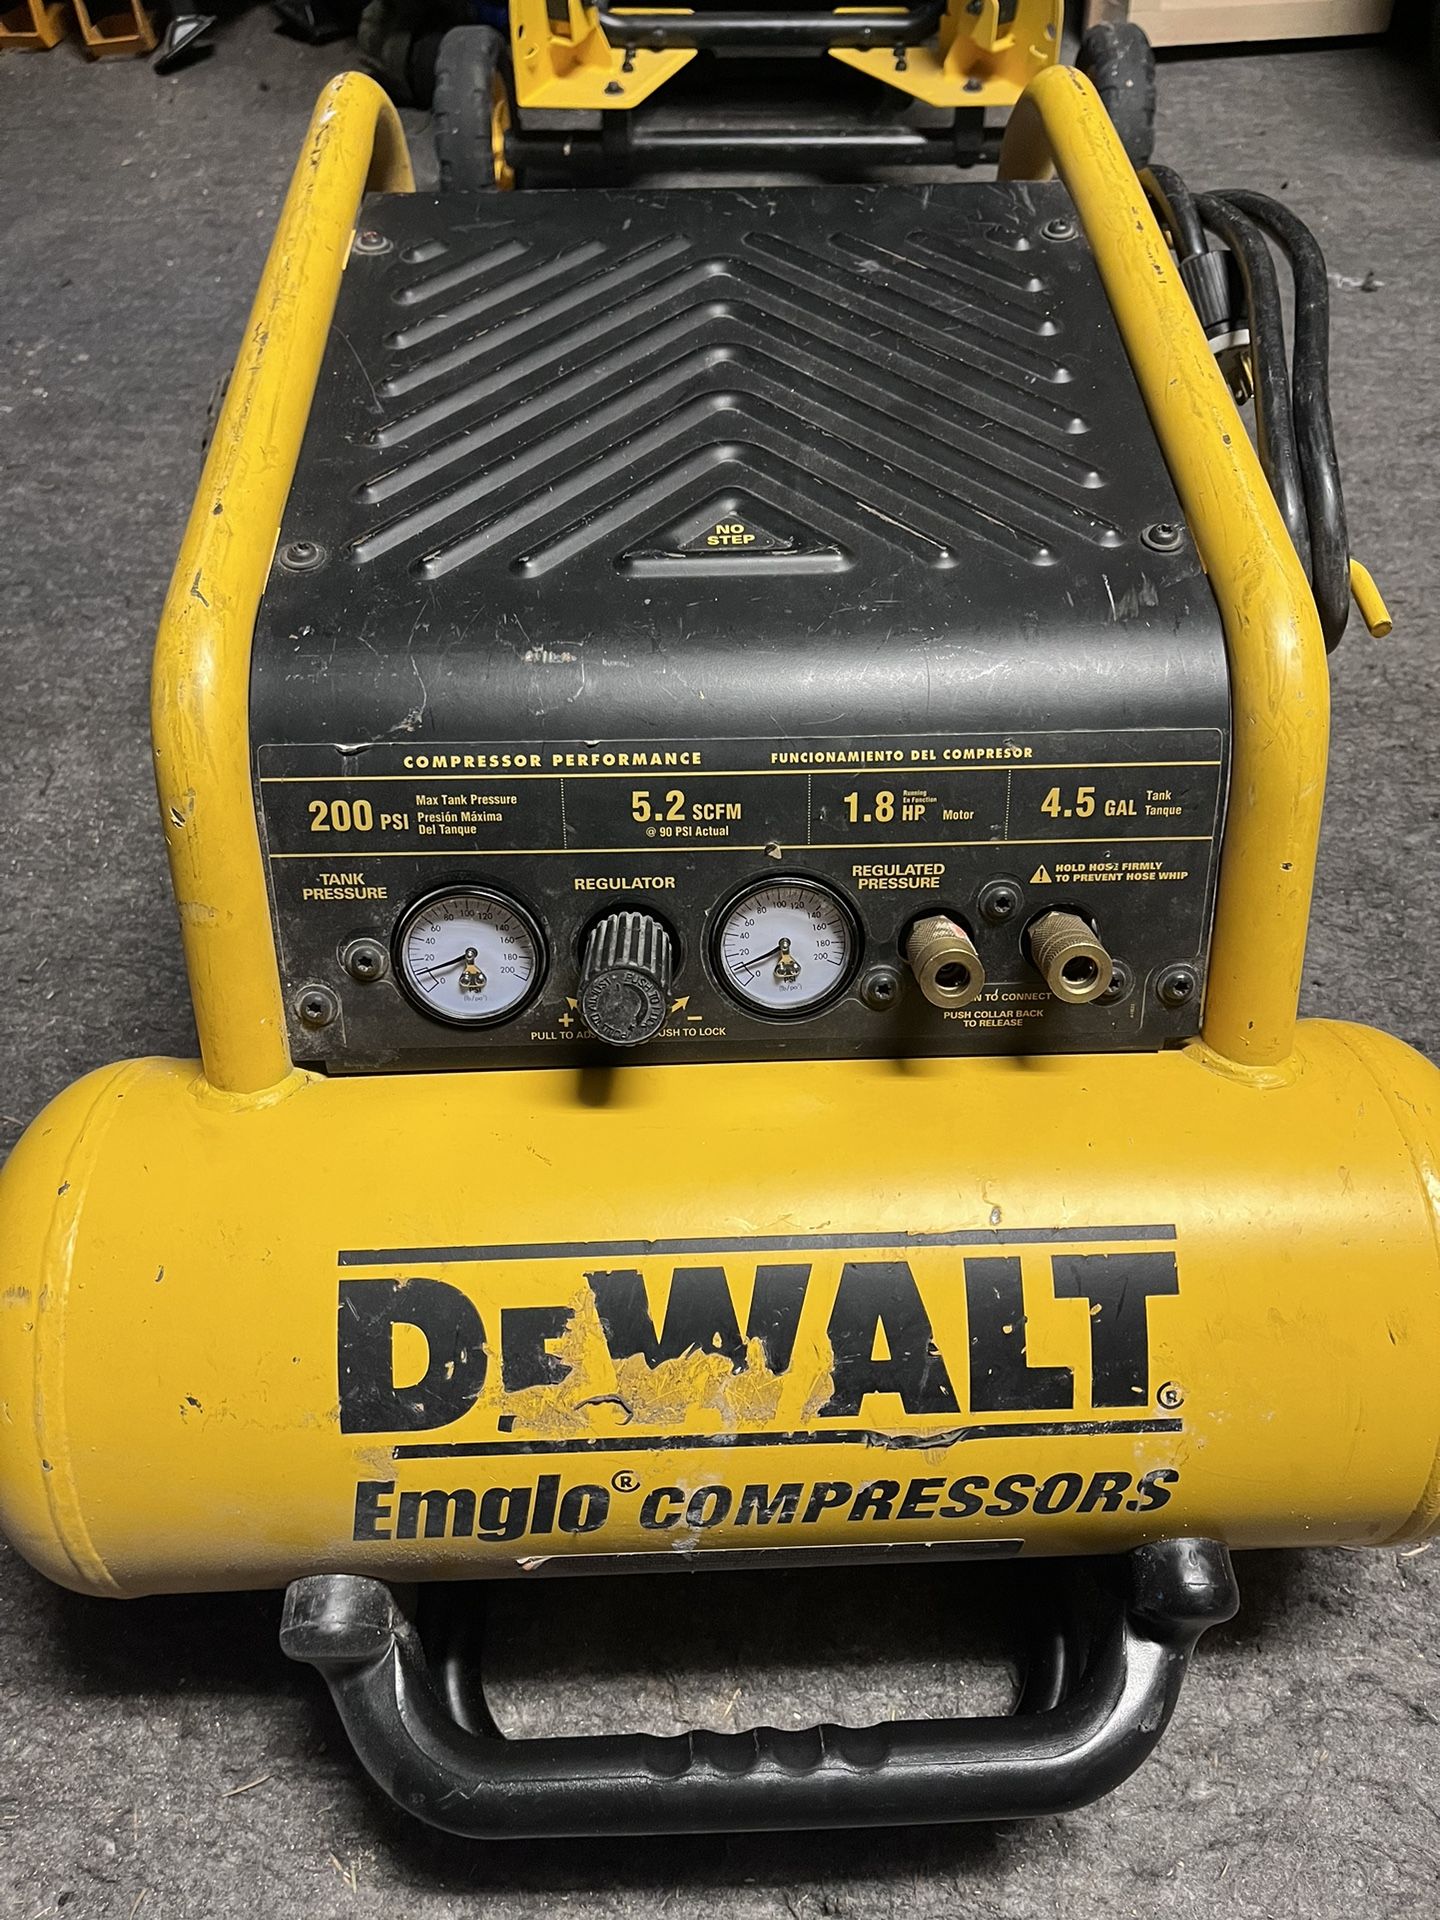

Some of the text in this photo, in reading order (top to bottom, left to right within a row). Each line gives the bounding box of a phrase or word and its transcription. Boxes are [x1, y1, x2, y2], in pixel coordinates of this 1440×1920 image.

[716, 524, 744, 534] NO
[707, 535, 755, 545] STEP
[403, 752, 701, 769] COMPRESSOR PERFORMANCE
[771, 747, 1033, 764] FUNCIONAMIENTO DEL COMPRESOR
[416, 794, 517, 806] Max Tank Pressure
[1146, 790, 1172, 801] Tank
[632, 790, 742, 823] 5.2 SCFM
[844, 791, 926, 823] 1.8 HP
[1040, 787, 1137, 818] 4.5 GAL
[308, 800, 409, 831] 200 PSI
[417, 810, 503, 823] Presión Máxima
[943, 809, 974, 820] Motor
[1145, 804, 1182, 817] Tanque
[418, 824, 477, 837] Del Tanque
[645, 825, 729, 838] @ 90 PSI Actual
[852, 864, 946, 877] REGULATED
[1055, 863, 1086, 872] HOLD
[1122, 862, 1163, 871] FIRMLY
[319, 873, 365, 885] TANK
[1055, 871, 1189, 882] TO PREVENT HOSE WHIP
[574, 876, 676, 890] REGULATOR
[858, 877, 940, 890] PRESSURE
[303, 887, 388, 900] PRESSURE
[478, 912, 493, 920] 120
[756, 906, 767, 914] 80
[807, 911, 821, 919] 140
[744, 919, 754, 927] 60
[813, 923, 826, 931] 160
[985, 993, 998, 1001] TO
[1001, 992, 1052, 1001] CONNECT
[943, 1009, 1044, 1019] PUSH COLLAR BACK
[979, 1019, 1023, 1027] RELEASE
[531, 1031, 557, 1040] PULL
[560, 1031, 574, 1039] TO
[658, 1027, 726, 1037] USH TO LOCK
[639, 1468, 1180, 1529] COMPRESSORS
